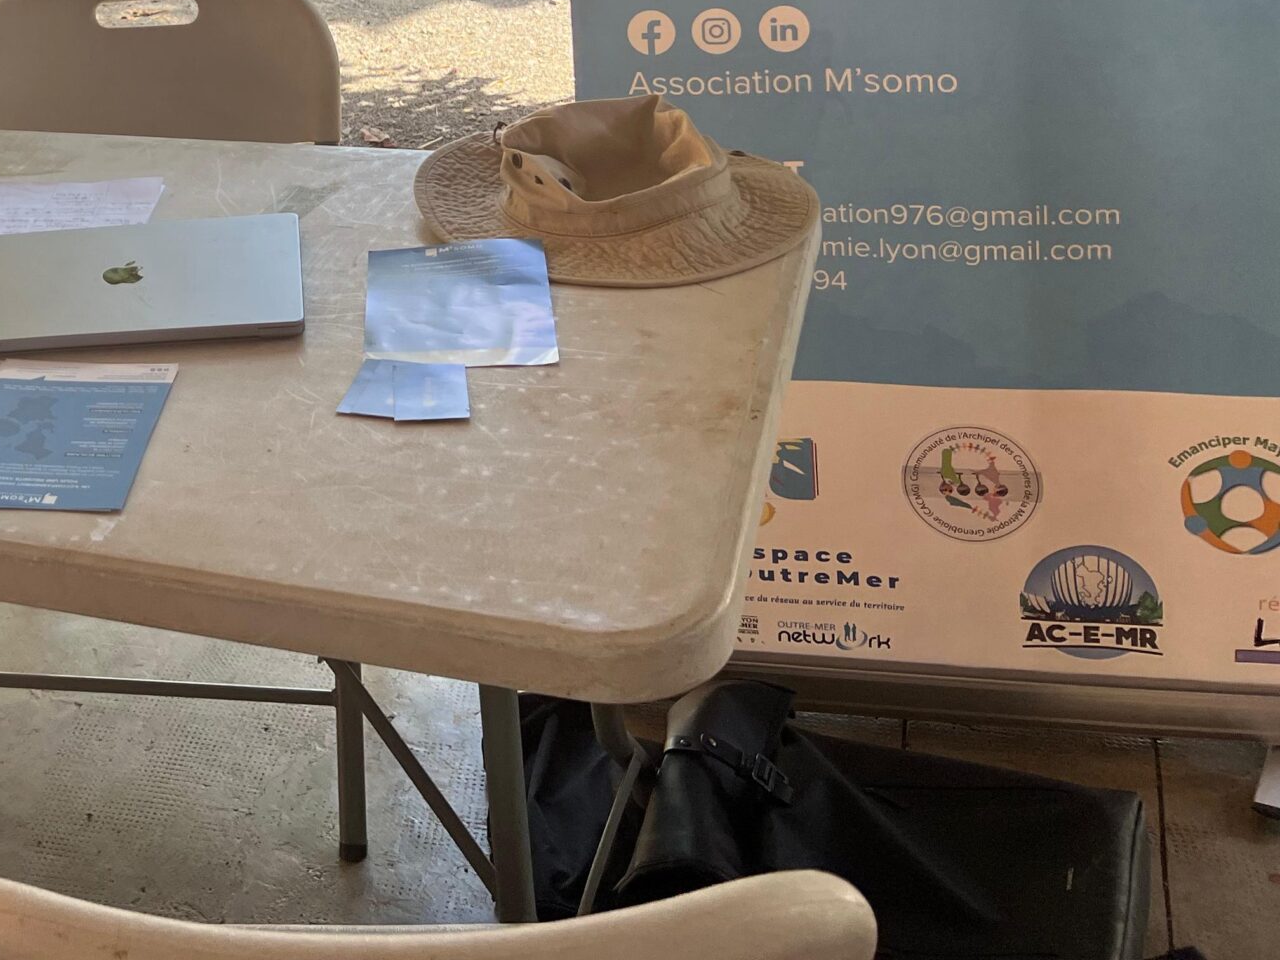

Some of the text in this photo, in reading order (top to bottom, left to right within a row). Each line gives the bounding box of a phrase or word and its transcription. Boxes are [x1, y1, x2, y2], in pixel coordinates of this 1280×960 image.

[628, 69, 812, 97] Association
[822, 203, 1121, 232] ation976@gmail.com
[822, 237, 1113, 266] mie.lyon@gmail.com
[1168, 435, 1250, 468] Emanciper
[753, 547, 853, 564] space
[749, 568, 900, 589] utreMer
[757, 594, 768, 603] du
[771, 596, 799, 604] réseau
[816, 598, 847, 607] service
[850, 599, 860, 608] du
[777, 620, 836, 631] OUTRE-MER
[1025, 622, 1159, 649] AC-E-MR
